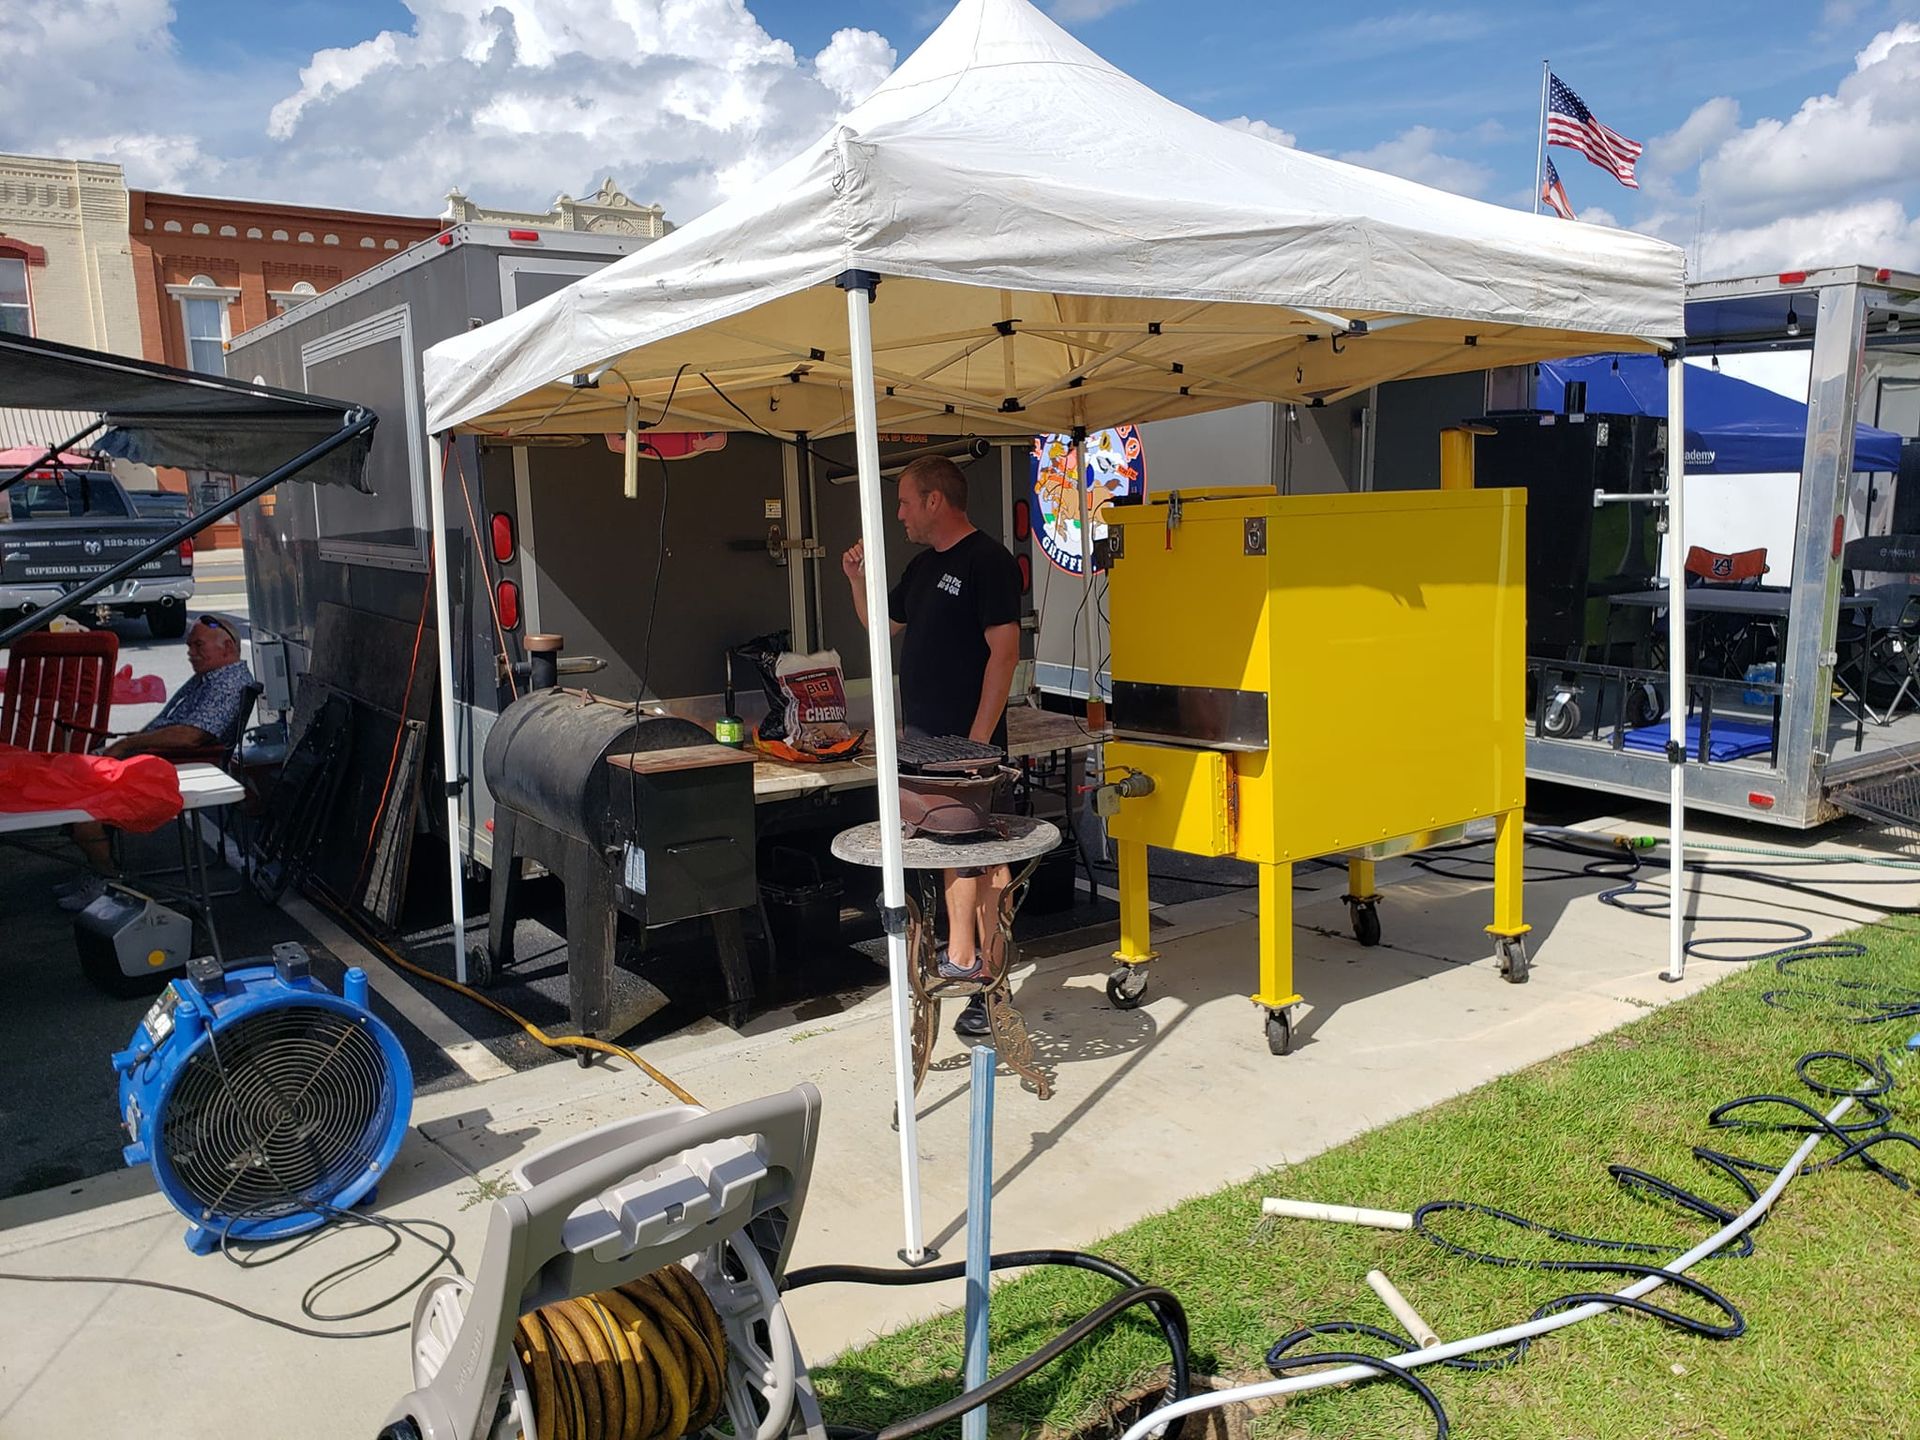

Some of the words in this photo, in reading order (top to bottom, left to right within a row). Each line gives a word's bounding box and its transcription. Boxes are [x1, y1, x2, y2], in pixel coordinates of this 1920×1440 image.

[1683, 448, 1716, 463] ademy
[1042, 536, 1084, 572] GRIFFI
[25, 565, 77, 576] SUPERIOR
[805, 706, 845, 722] CHERRY
